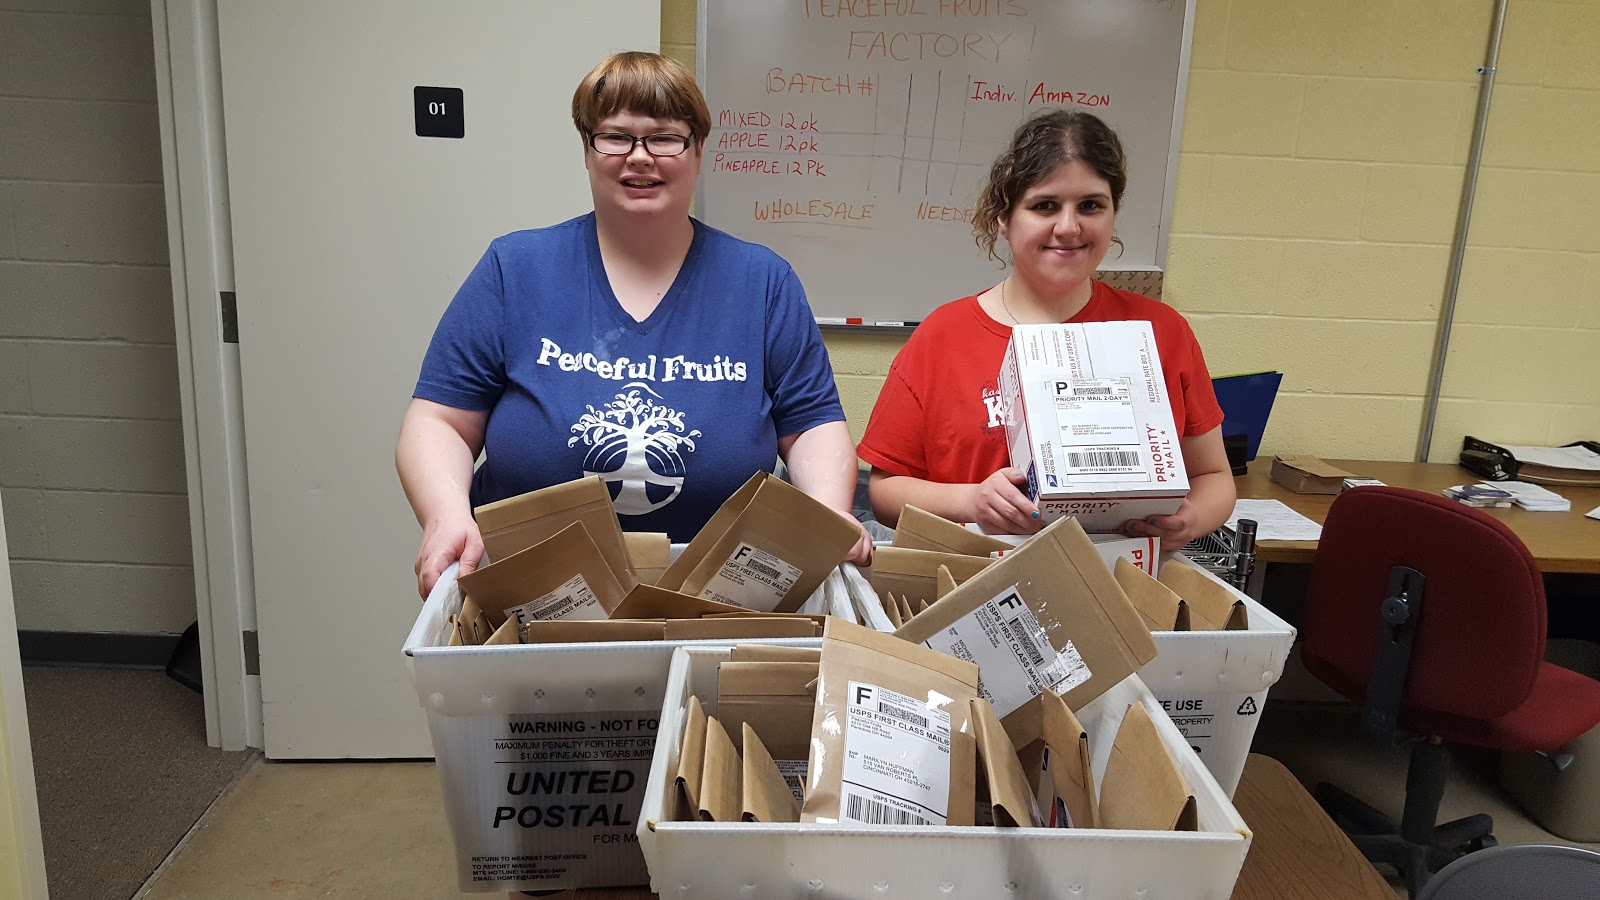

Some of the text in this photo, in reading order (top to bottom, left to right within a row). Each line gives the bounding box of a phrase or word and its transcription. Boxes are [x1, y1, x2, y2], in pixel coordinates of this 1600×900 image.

[939, 0, 1029, 18] FRUITS
[766, 66, 873, 96] BATCH #
[428, 101, 446, 115] 01
[719, 109, 771, 128] MIXED
[718, 132, 770, 149] APPLE
[713, 153, 780, 174] PINEAPPLE
[754, 199, 875, 221] WHOLESALE
[536, 337, 747, 382] Peaceful Fruits
[1055, 381, 1068, 395] P
[1161, 439, 1176, 468] MAIL
[734, 545, 752, 560] F
[725, 560, 739, 571] USPS
[739, 567, 755, 577] FIRST
[754, 573, 771, 585] CLASS
[998, 592, 1023, 609] F
[553, 605, 574, 619] CLASS
[986, 601, 1002, 622] USPS
[999, 621, 1015, 643] FIRST
[1012, 643, 1030, 668] CLASS
[856, 686, 872, 705] F
[1175, 700, 1203, 711] USE
[509, 720, 586, 733] WARNING
[600, 719, 632, 732] NOT
[850, 707, 872, 719] USPS
[874, 713, 897, 726] FIRST
[898, 721, 925, 736] CLASS
[495, 739, 650, 750] MAXIMUM PENALTY FOR THEFT OR
[550, 752, 571, 760] FINE
[571, 751, 592, 759] AND
[600, 750, 631, 758] YEARS
[863, 754, 915, 775] MARILYN HUFFMAN
[863, 764, 893, 778] CINCINNATI
[873, 762, 885, 770] VAN
[885, 766, 911, 779] ROBERTS
[507, 769, 635, 796] UNITED
[872, 793, 888, 802] USPS
[888, 798, 917, 813] TRACKING
[493, 803, 632, 829] POSTAL
[593, 834, 620, 844] FOR
